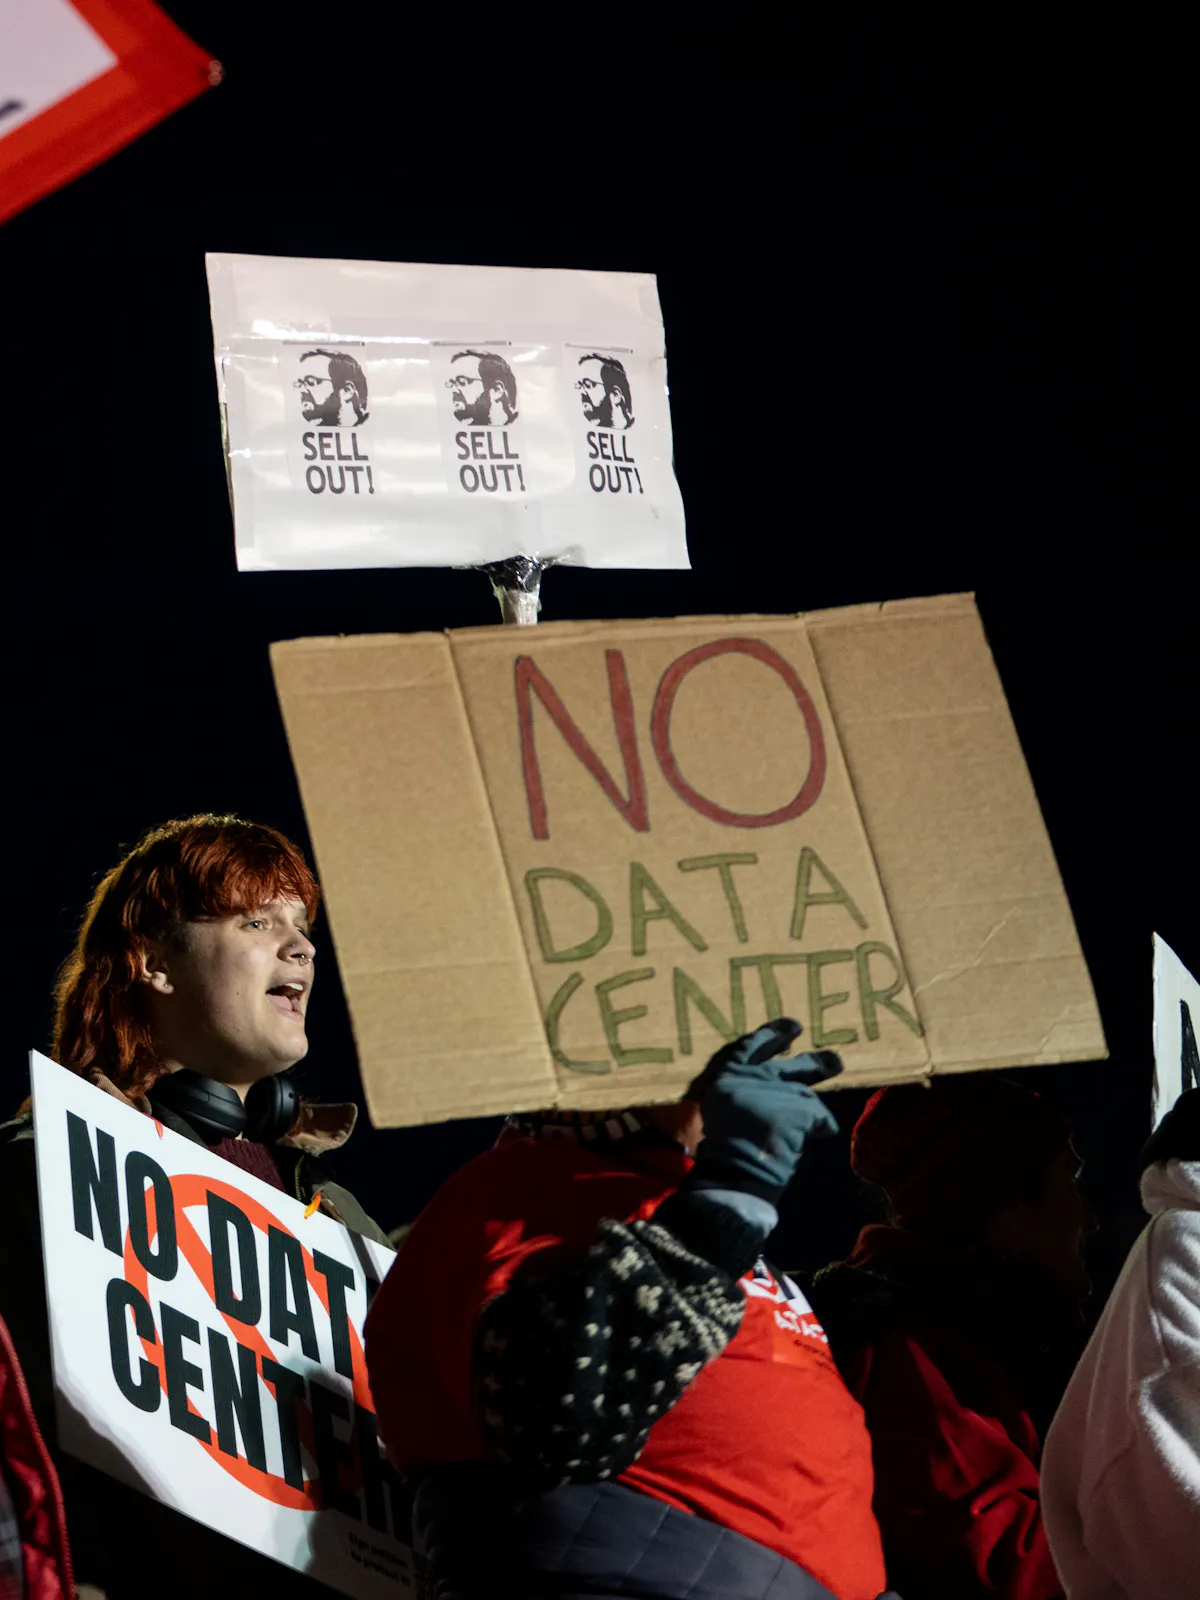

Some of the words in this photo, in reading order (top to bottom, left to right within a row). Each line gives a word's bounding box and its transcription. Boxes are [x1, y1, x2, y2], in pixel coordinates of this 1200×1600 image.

[302, 431, 369, 461] SELL
[455, 431, 519, 460] SELL
[586, 432, 635, 463] SELL
[306, 464, 375, 494] OUT!
[459, 464, 526, 493] OUT!
[589, 465, 644, 494] OUT!
[514, 636, 826, 840] NO
[525, 847, 868, 963] DATA
[547, 941, 926, 1075] CENTER
[66, 1109, 179, 1282] NO
[206, 1189, 382, 1380] DAT
